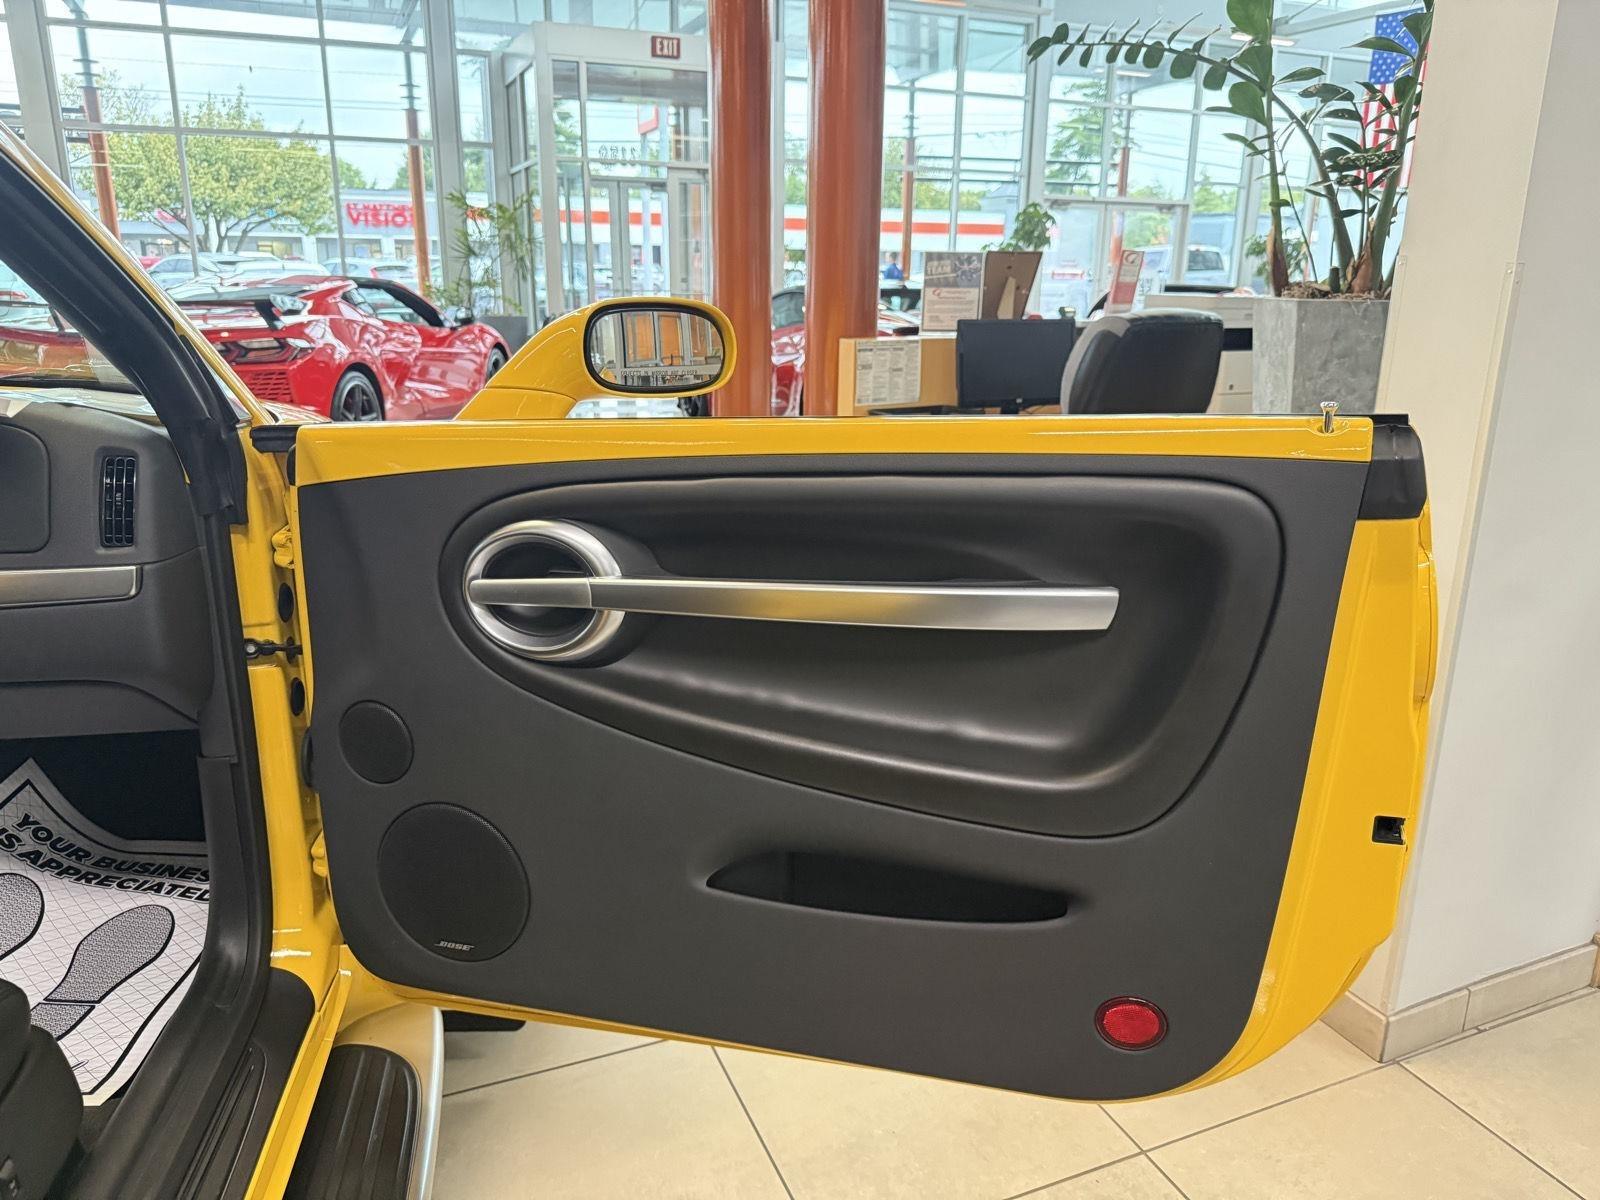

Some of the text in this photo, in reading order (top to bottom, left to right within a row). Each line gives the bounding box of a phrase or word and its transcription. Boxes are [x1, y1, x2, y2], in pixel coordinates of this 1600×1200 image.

[655, 37, 678, 57] EXIT
[346, 208, 415, 228] VISIO
[13, 812, 93, 866] YOUR
